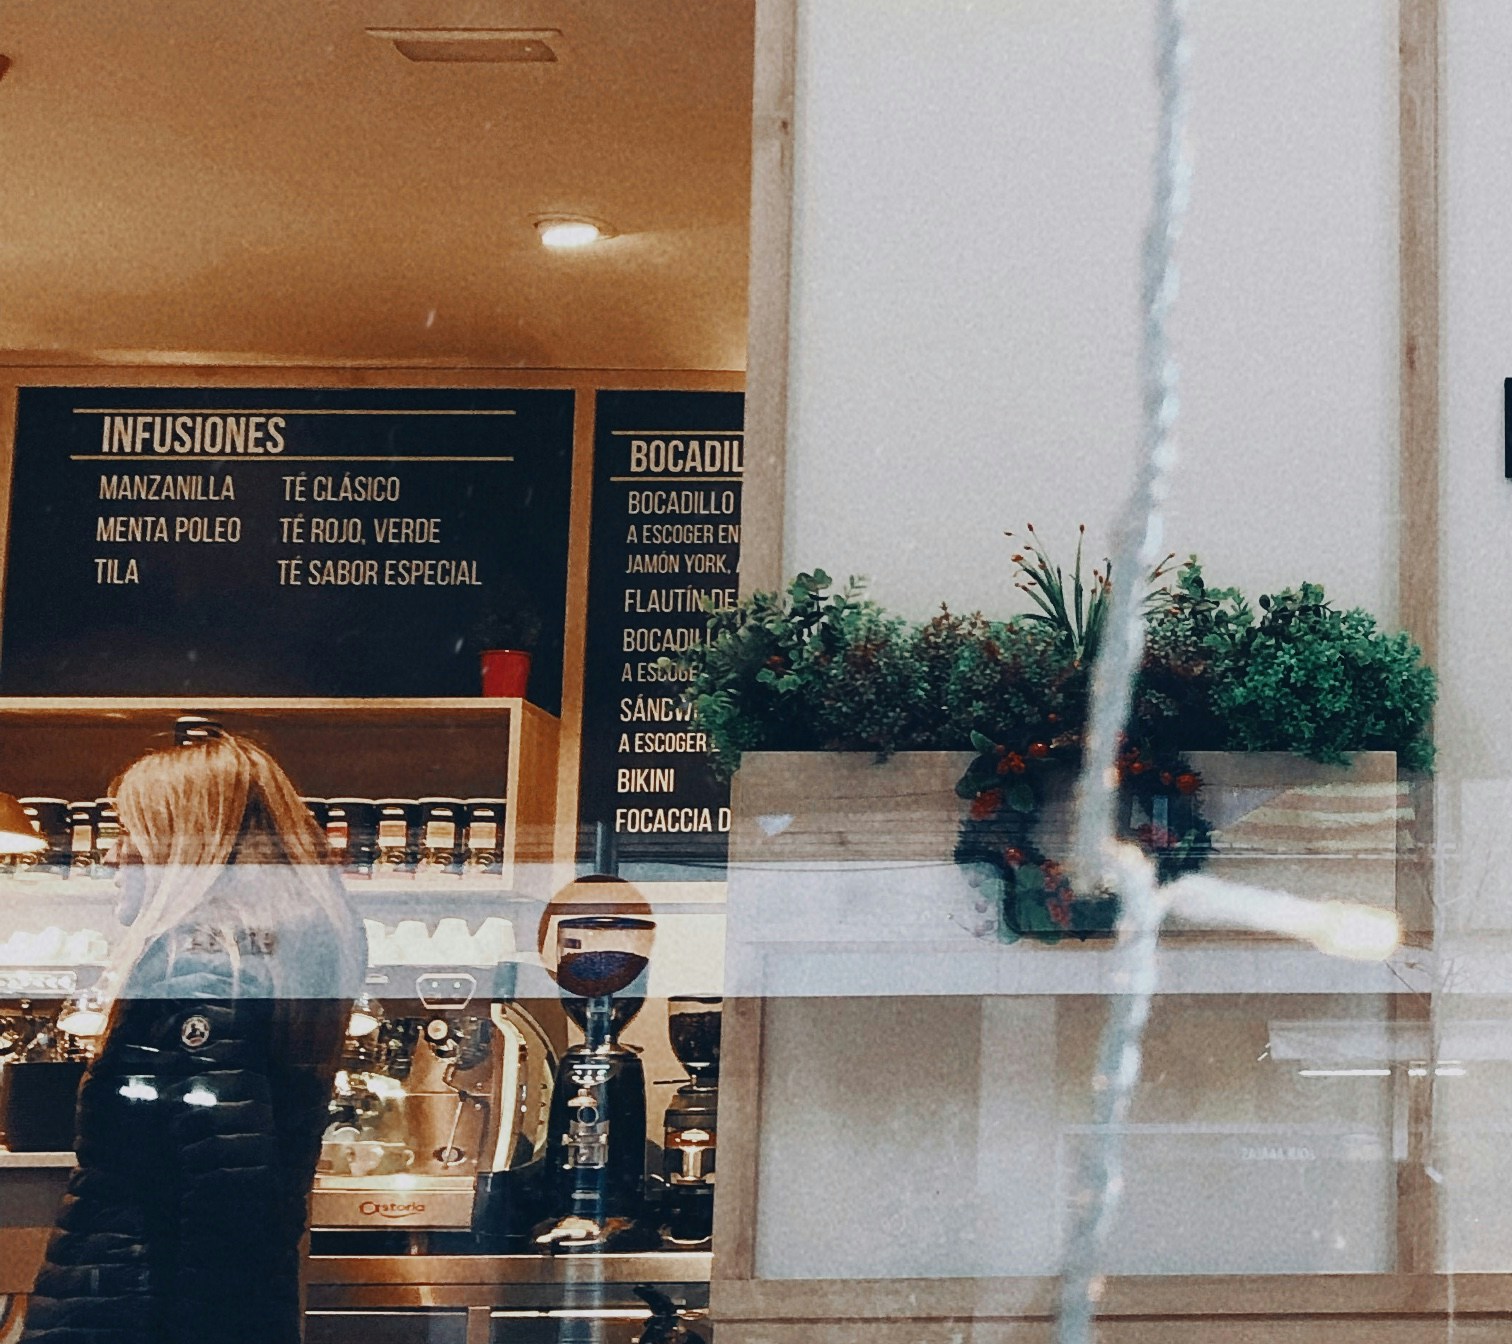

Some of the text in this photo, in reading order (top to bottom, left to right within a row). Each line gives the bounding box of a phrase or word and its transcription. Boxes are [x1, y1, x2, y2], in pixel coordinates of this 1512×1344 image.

[102, 416, 286, 453] INFUSIONES
[99, 475, 235, 500] MANZANILLA
[282, 471, 400, 501] TÉ CLÁSICO
[628, 491, 734, 514] BOCADILLO
[96, 517, 241, 542] MENTA POLEO
[279, 513, 441, 545] TÉ ROJO, VERDE
[626, 524, 741, 544] A ESCOGER EN
[94, 559, 139, 584] TILA
[277, 555, 483, 585] TÉ SABOR ESPECIAL
[625, 550, 679, 573] JAMÓN
[684, 554, 731, 575] YORK,
[624, 584, 705, 612] FLAUTÍN
[621, 662, 633, 682] A
[618, 733, 630, 753] A
[634, 732, 707, 753] ESCOGER
[617, 768, 674, 793] BIKINI
[615, 807, 713, 833] FOCACCIA
